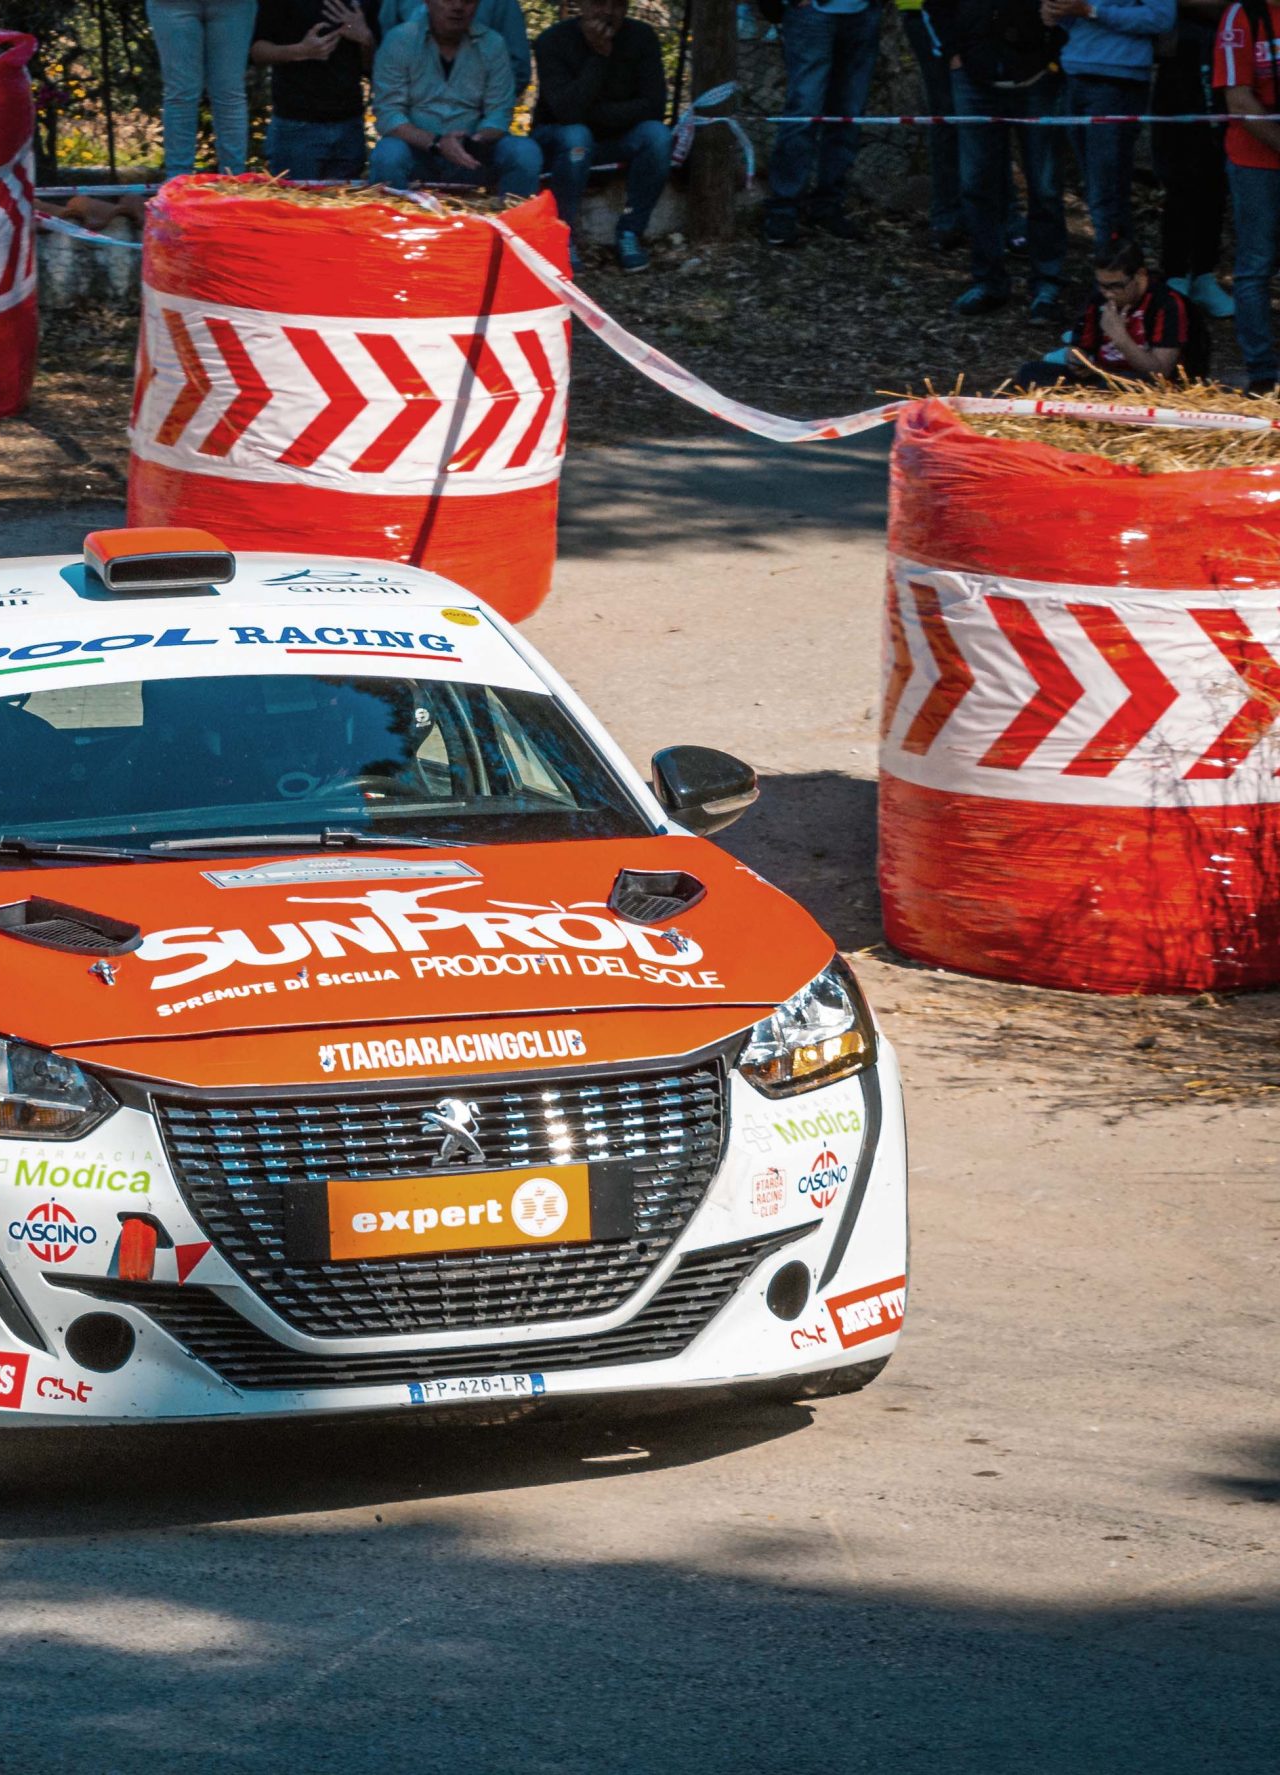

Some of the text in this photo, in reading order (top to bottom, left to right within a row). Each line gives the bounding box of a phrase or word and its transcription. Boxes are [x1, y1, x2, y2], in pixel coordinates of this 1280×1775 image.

[229, 625, 456, 652] RACING
[410, 954, 725, 988] PRODOTTI DEL SOLE
[156, 981, 278, 1017] SPREMUTE
[318, 1029, 587, 1072] #TARGARACINGCLUB
[772, 1108, 861, 1145] Modica
[14, 1160, 151, 1194] Modica
[798, 1165, 848, 1194] CASCINO
[8, 1220, 97, 1244] CASCINO
[352, 1199, 503, 1234] expert
[836, 1295, 882, 1336] MRF
[423, 1376, 526, 1398] FP-426-LR
